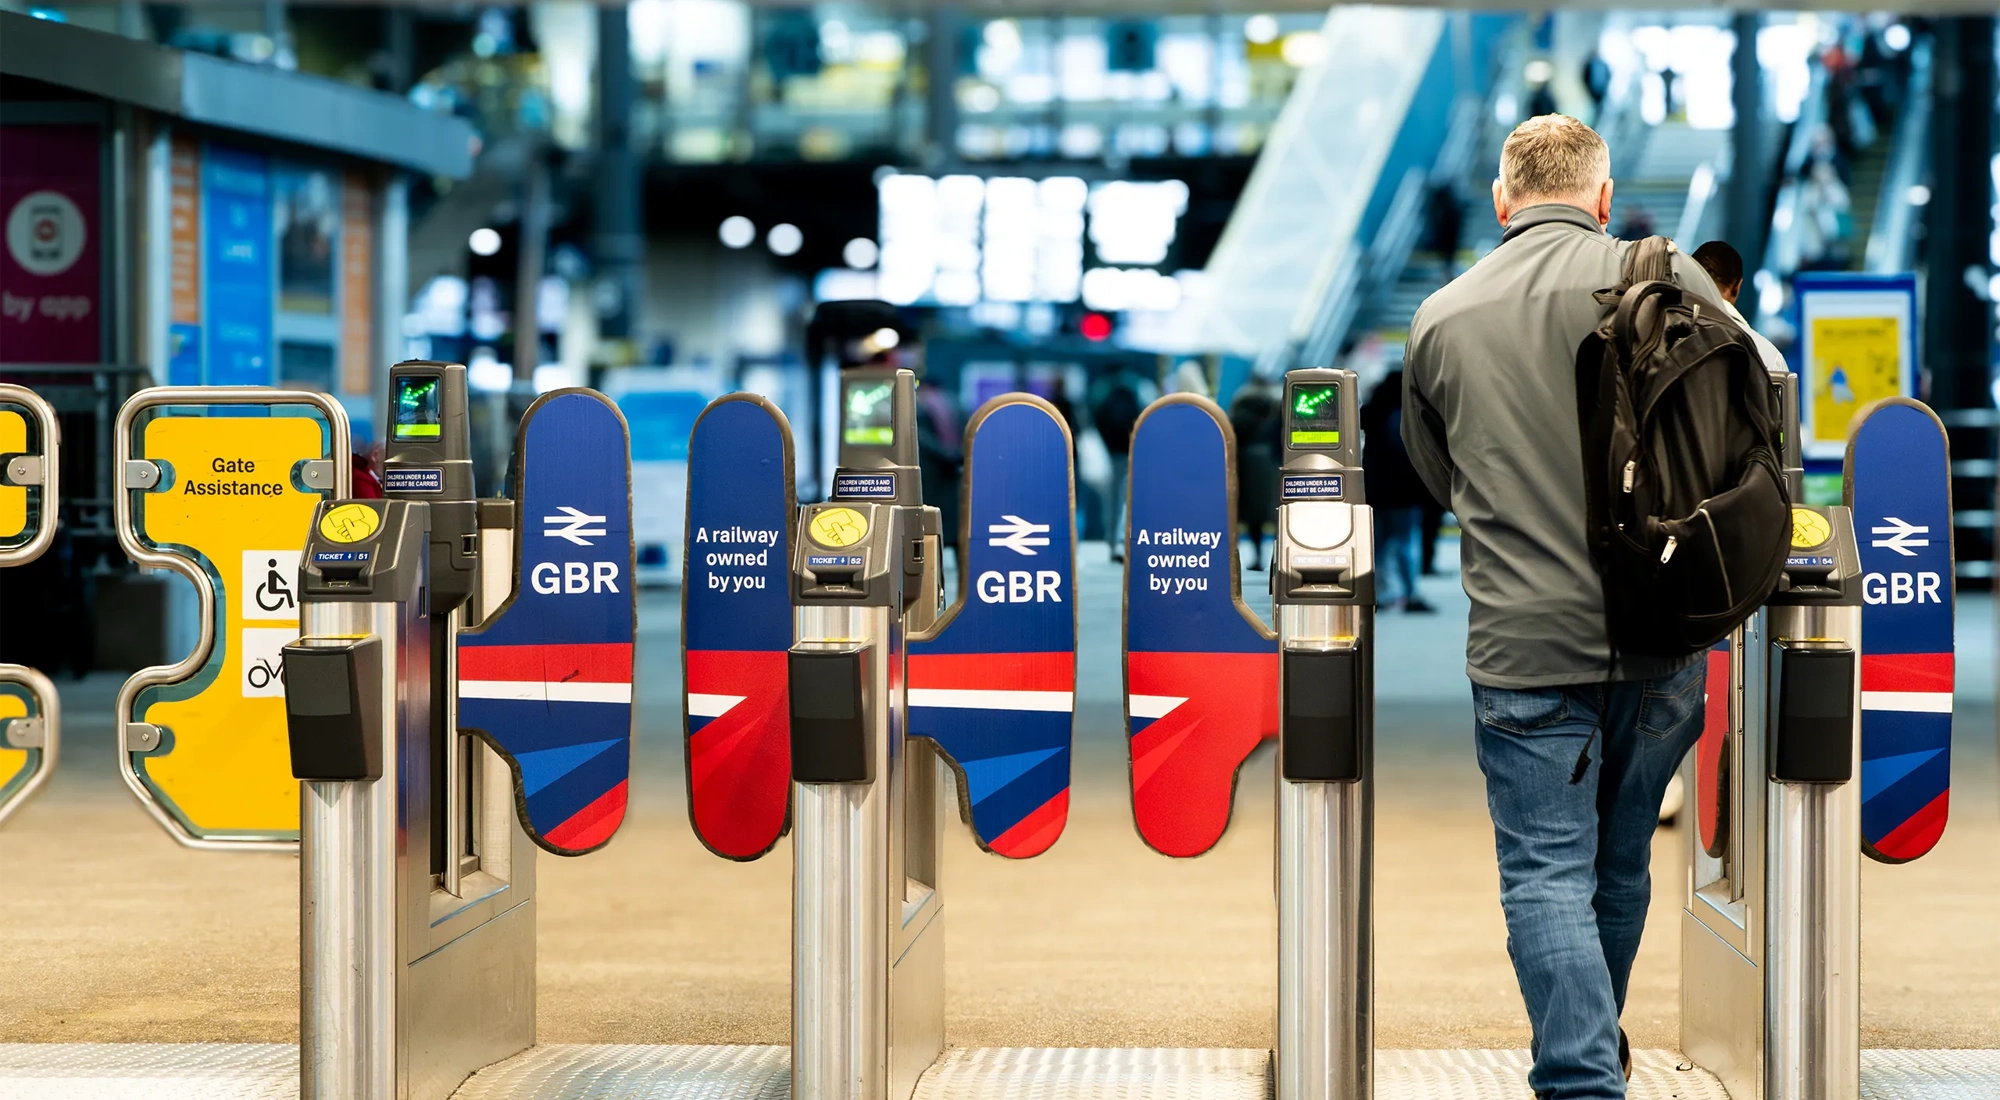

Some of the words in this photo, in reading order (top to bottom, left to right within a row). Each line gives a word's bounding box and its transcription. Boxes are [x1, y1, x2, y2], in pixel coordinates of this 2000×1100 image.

[2, 290, 34, 323] by
[39, 294, 91, 321] app
[212, 457, 255, 473] Gate
[184, 479, 283, 495] Assistance
[696, 527, 709, 543] A
[713, 526, 779, 547] railway
[1137, 529, 1150, 545] A
[1154, 528, 1222, 549] railway
[706, 549, 767, 566] owned
[1147, 551, 1210, 568] owned
[531, 561, 620, 594] GBR
[708, 571, 730, 593] by
[732, 576, 766, 593] you
[976, 570, 1062, 604] GBR
[1150, 573, 1172, 595] by
[1174, 577, 1208, 595] you
[1862, 571, 1942, 605] GBR
